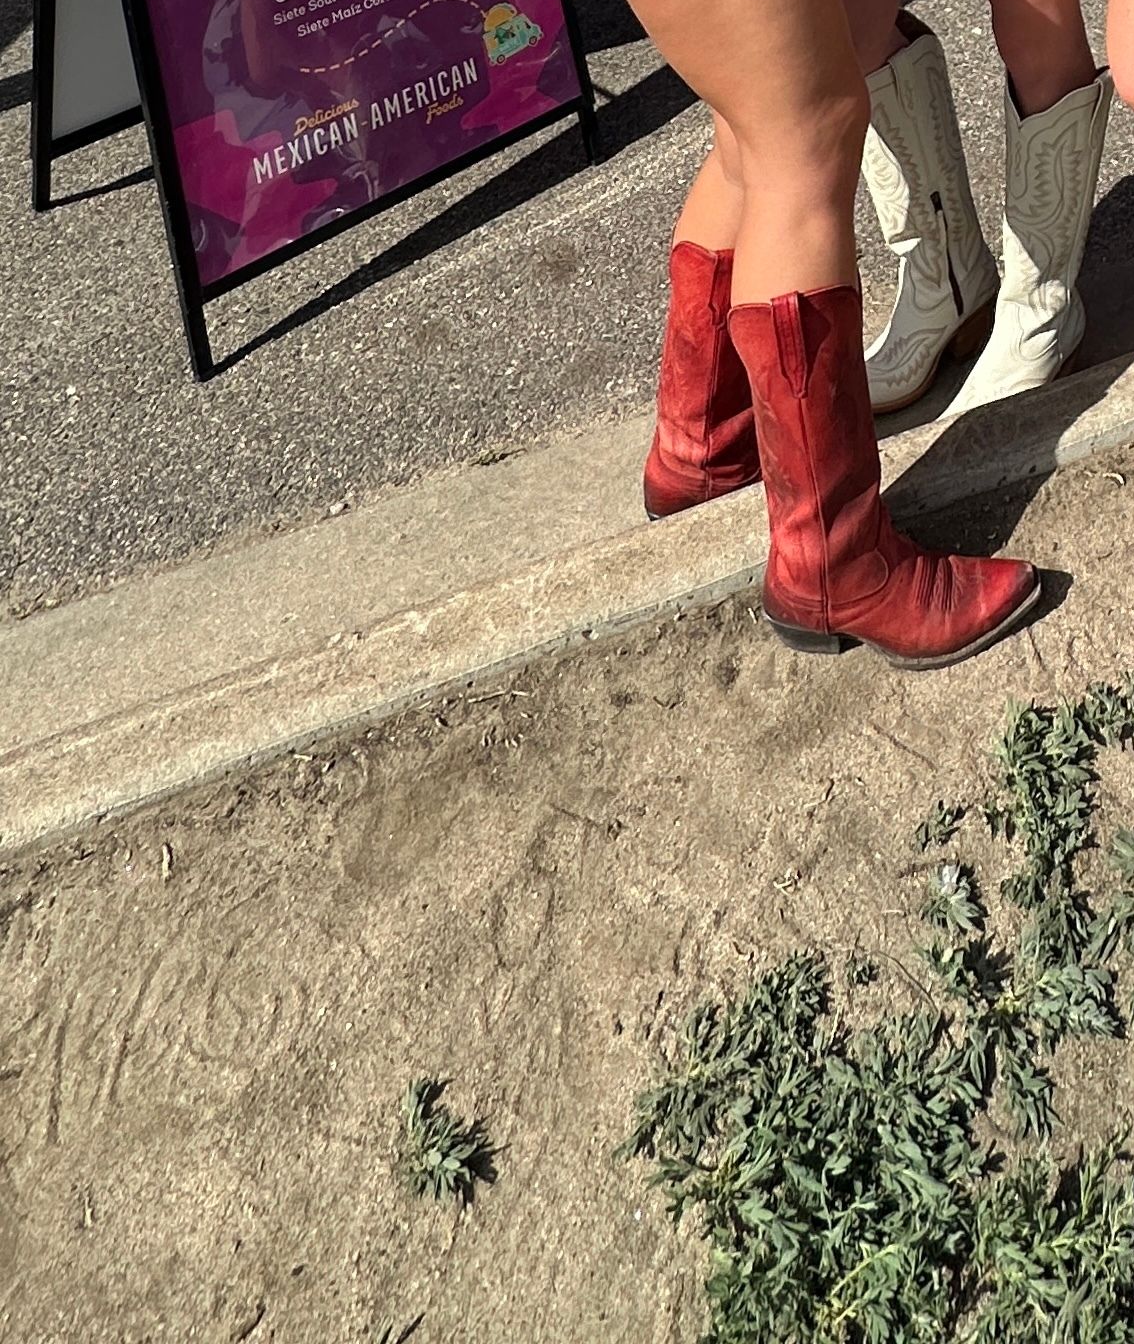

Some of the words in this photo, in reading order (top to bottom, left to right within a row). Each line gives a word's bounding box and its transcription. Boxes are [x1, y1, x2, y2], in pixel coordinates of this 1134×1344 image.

[273, 5, 306, 27] Siete
[297, 17, 331, 38] Siete
[293, 97, 360, 137] Delicious
[425, 92, 465, 126] Foods
